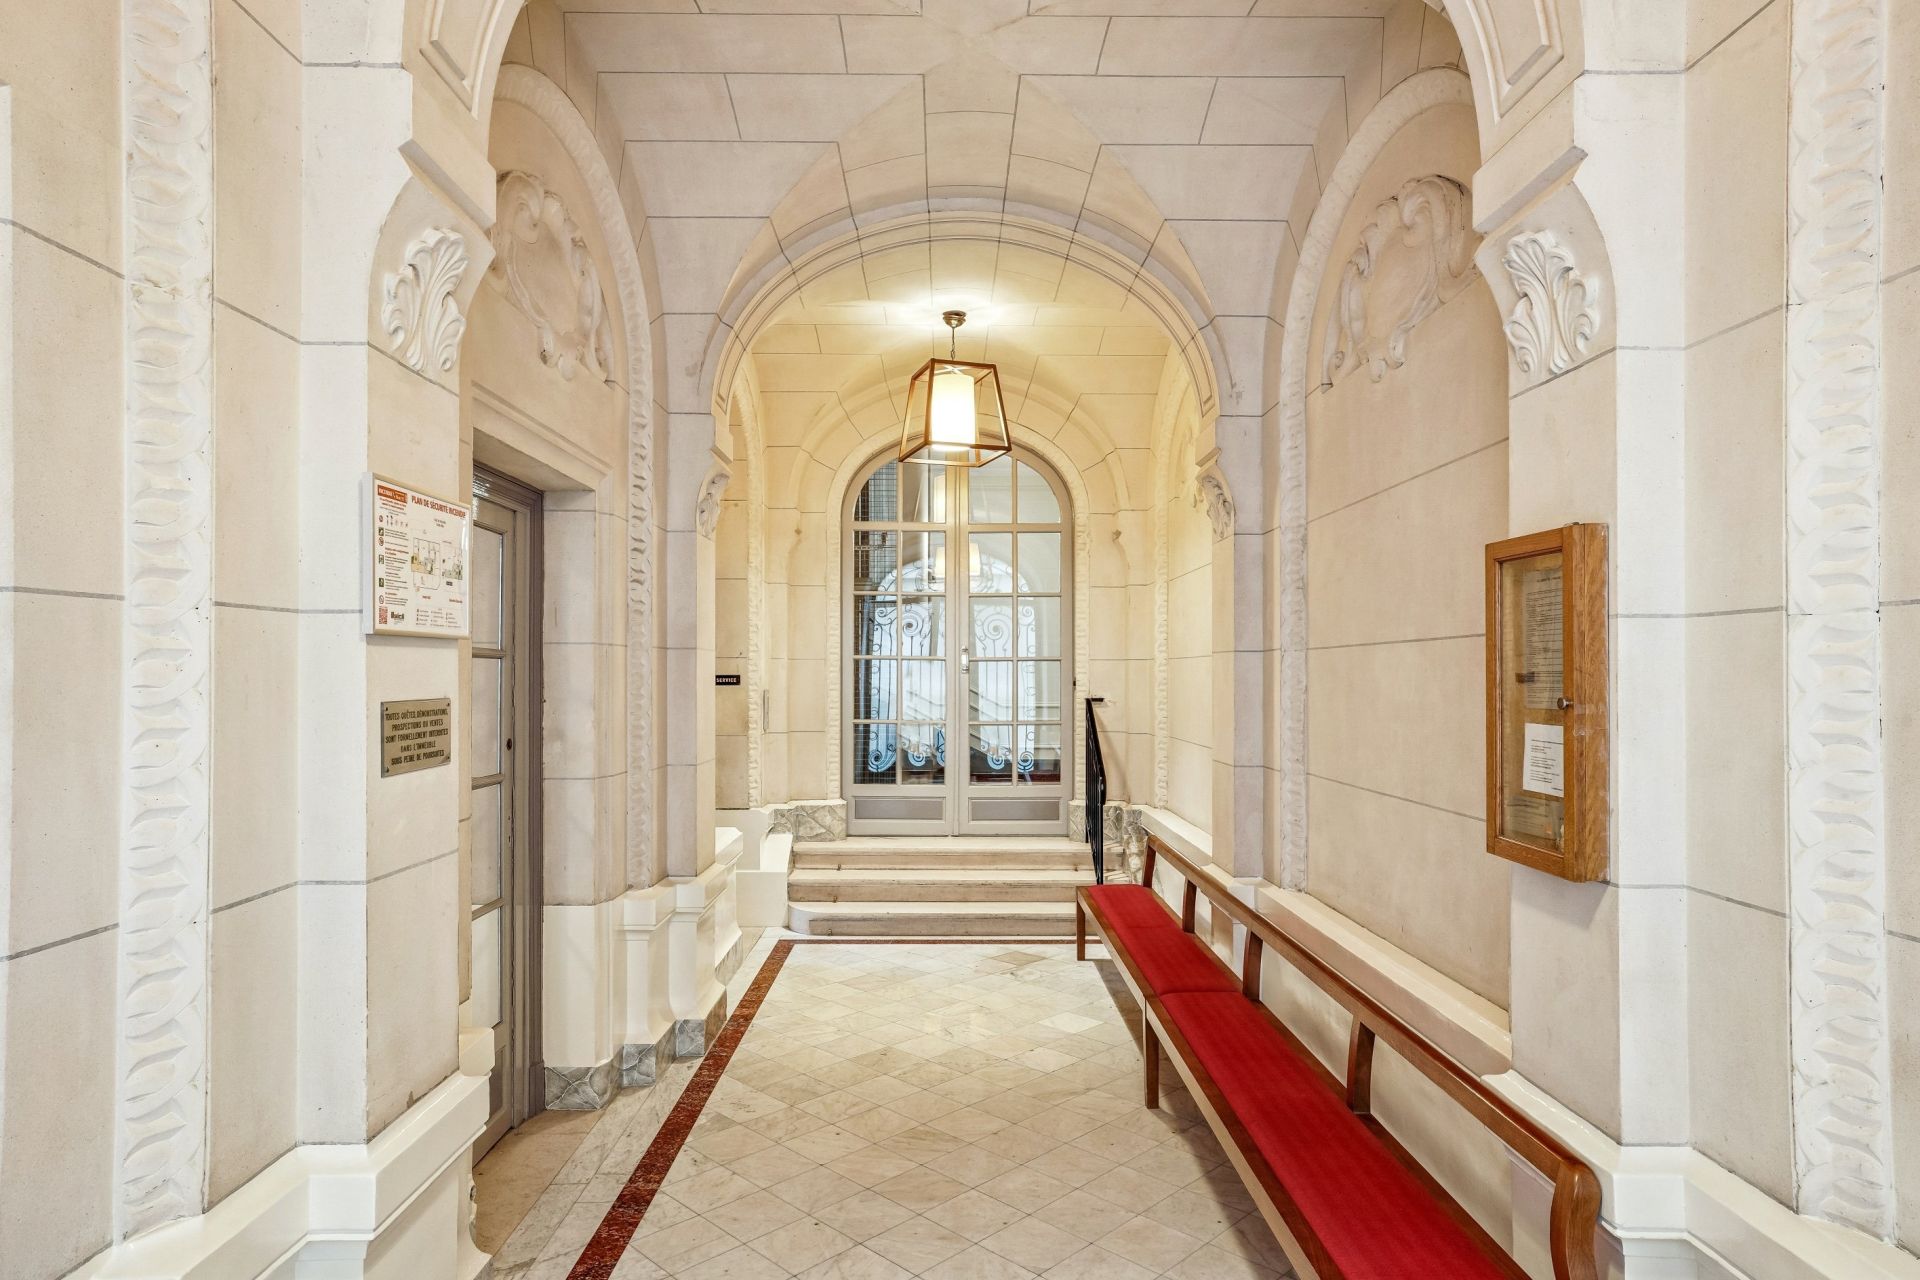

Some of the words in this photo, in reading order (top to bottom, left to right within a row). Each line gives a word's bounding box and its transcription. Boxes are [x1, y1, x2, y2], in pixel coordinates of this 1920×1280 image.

[412, 495, 422, 505] PLAN
[424, 500, 430, 508] DE
[385, 712, 400, 720] TOUTES
[392, 721, 421, 732] PROSPECTIONS
[422, 720, 428, 728] OU
[430, 718, 444, 727] VENTES
[385, 734, 396, 744] SONT
[398, 730, 428, 742] FORMELLEMENT
[428, 728, 448, 738] INTERDITES
[400, 744, 412, 753] DANS
[414, 740, 437, 752] L'IMMEUBLE
[391, 756, 402, 765] SOUS
[404, 754, 416, 764] PEINE
[416, 752, 422, 761] DE
[422, 750, 445, 760] POURSUITES
